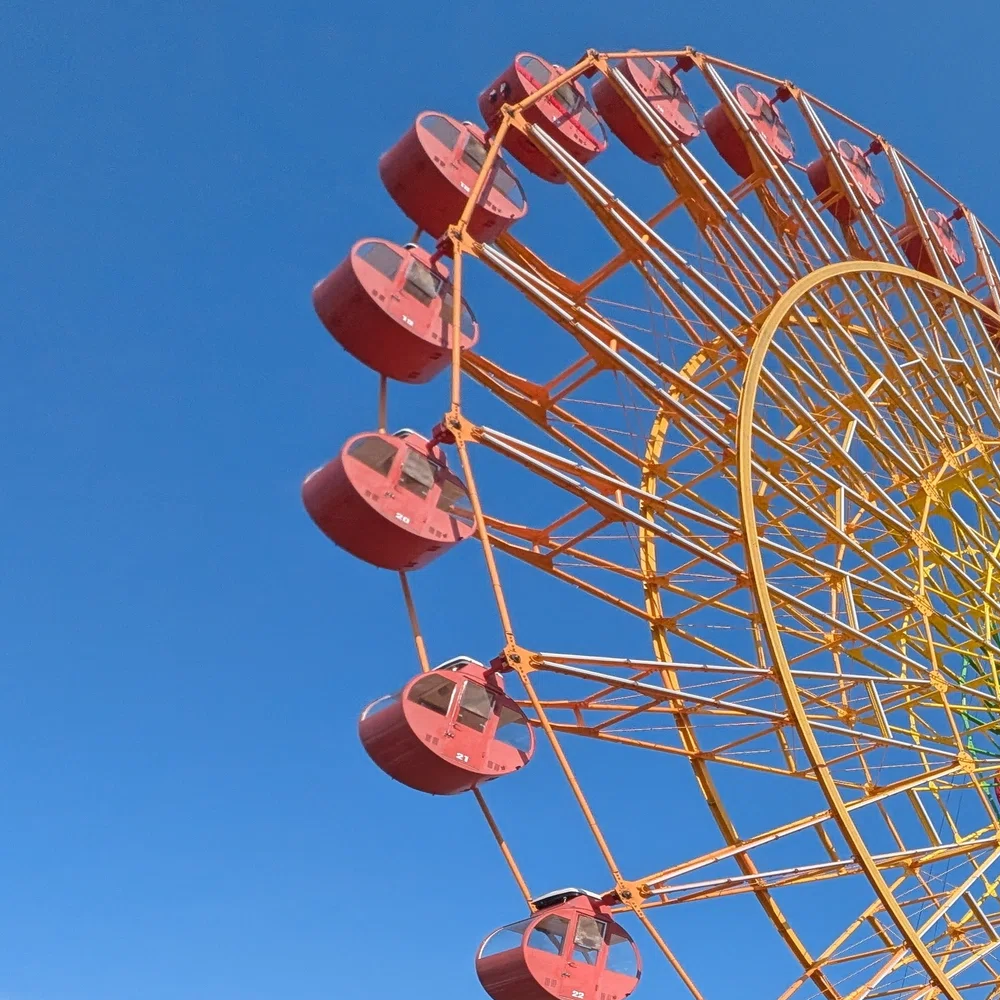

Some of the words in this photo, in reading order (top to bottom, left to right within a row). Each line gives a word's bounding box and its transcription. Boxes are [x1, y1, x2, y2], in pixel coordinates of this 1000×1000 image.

[395, 512, 410, 525] 20
[455, 752, 469, 763] 21
[571, 990, 585, 999] 22
